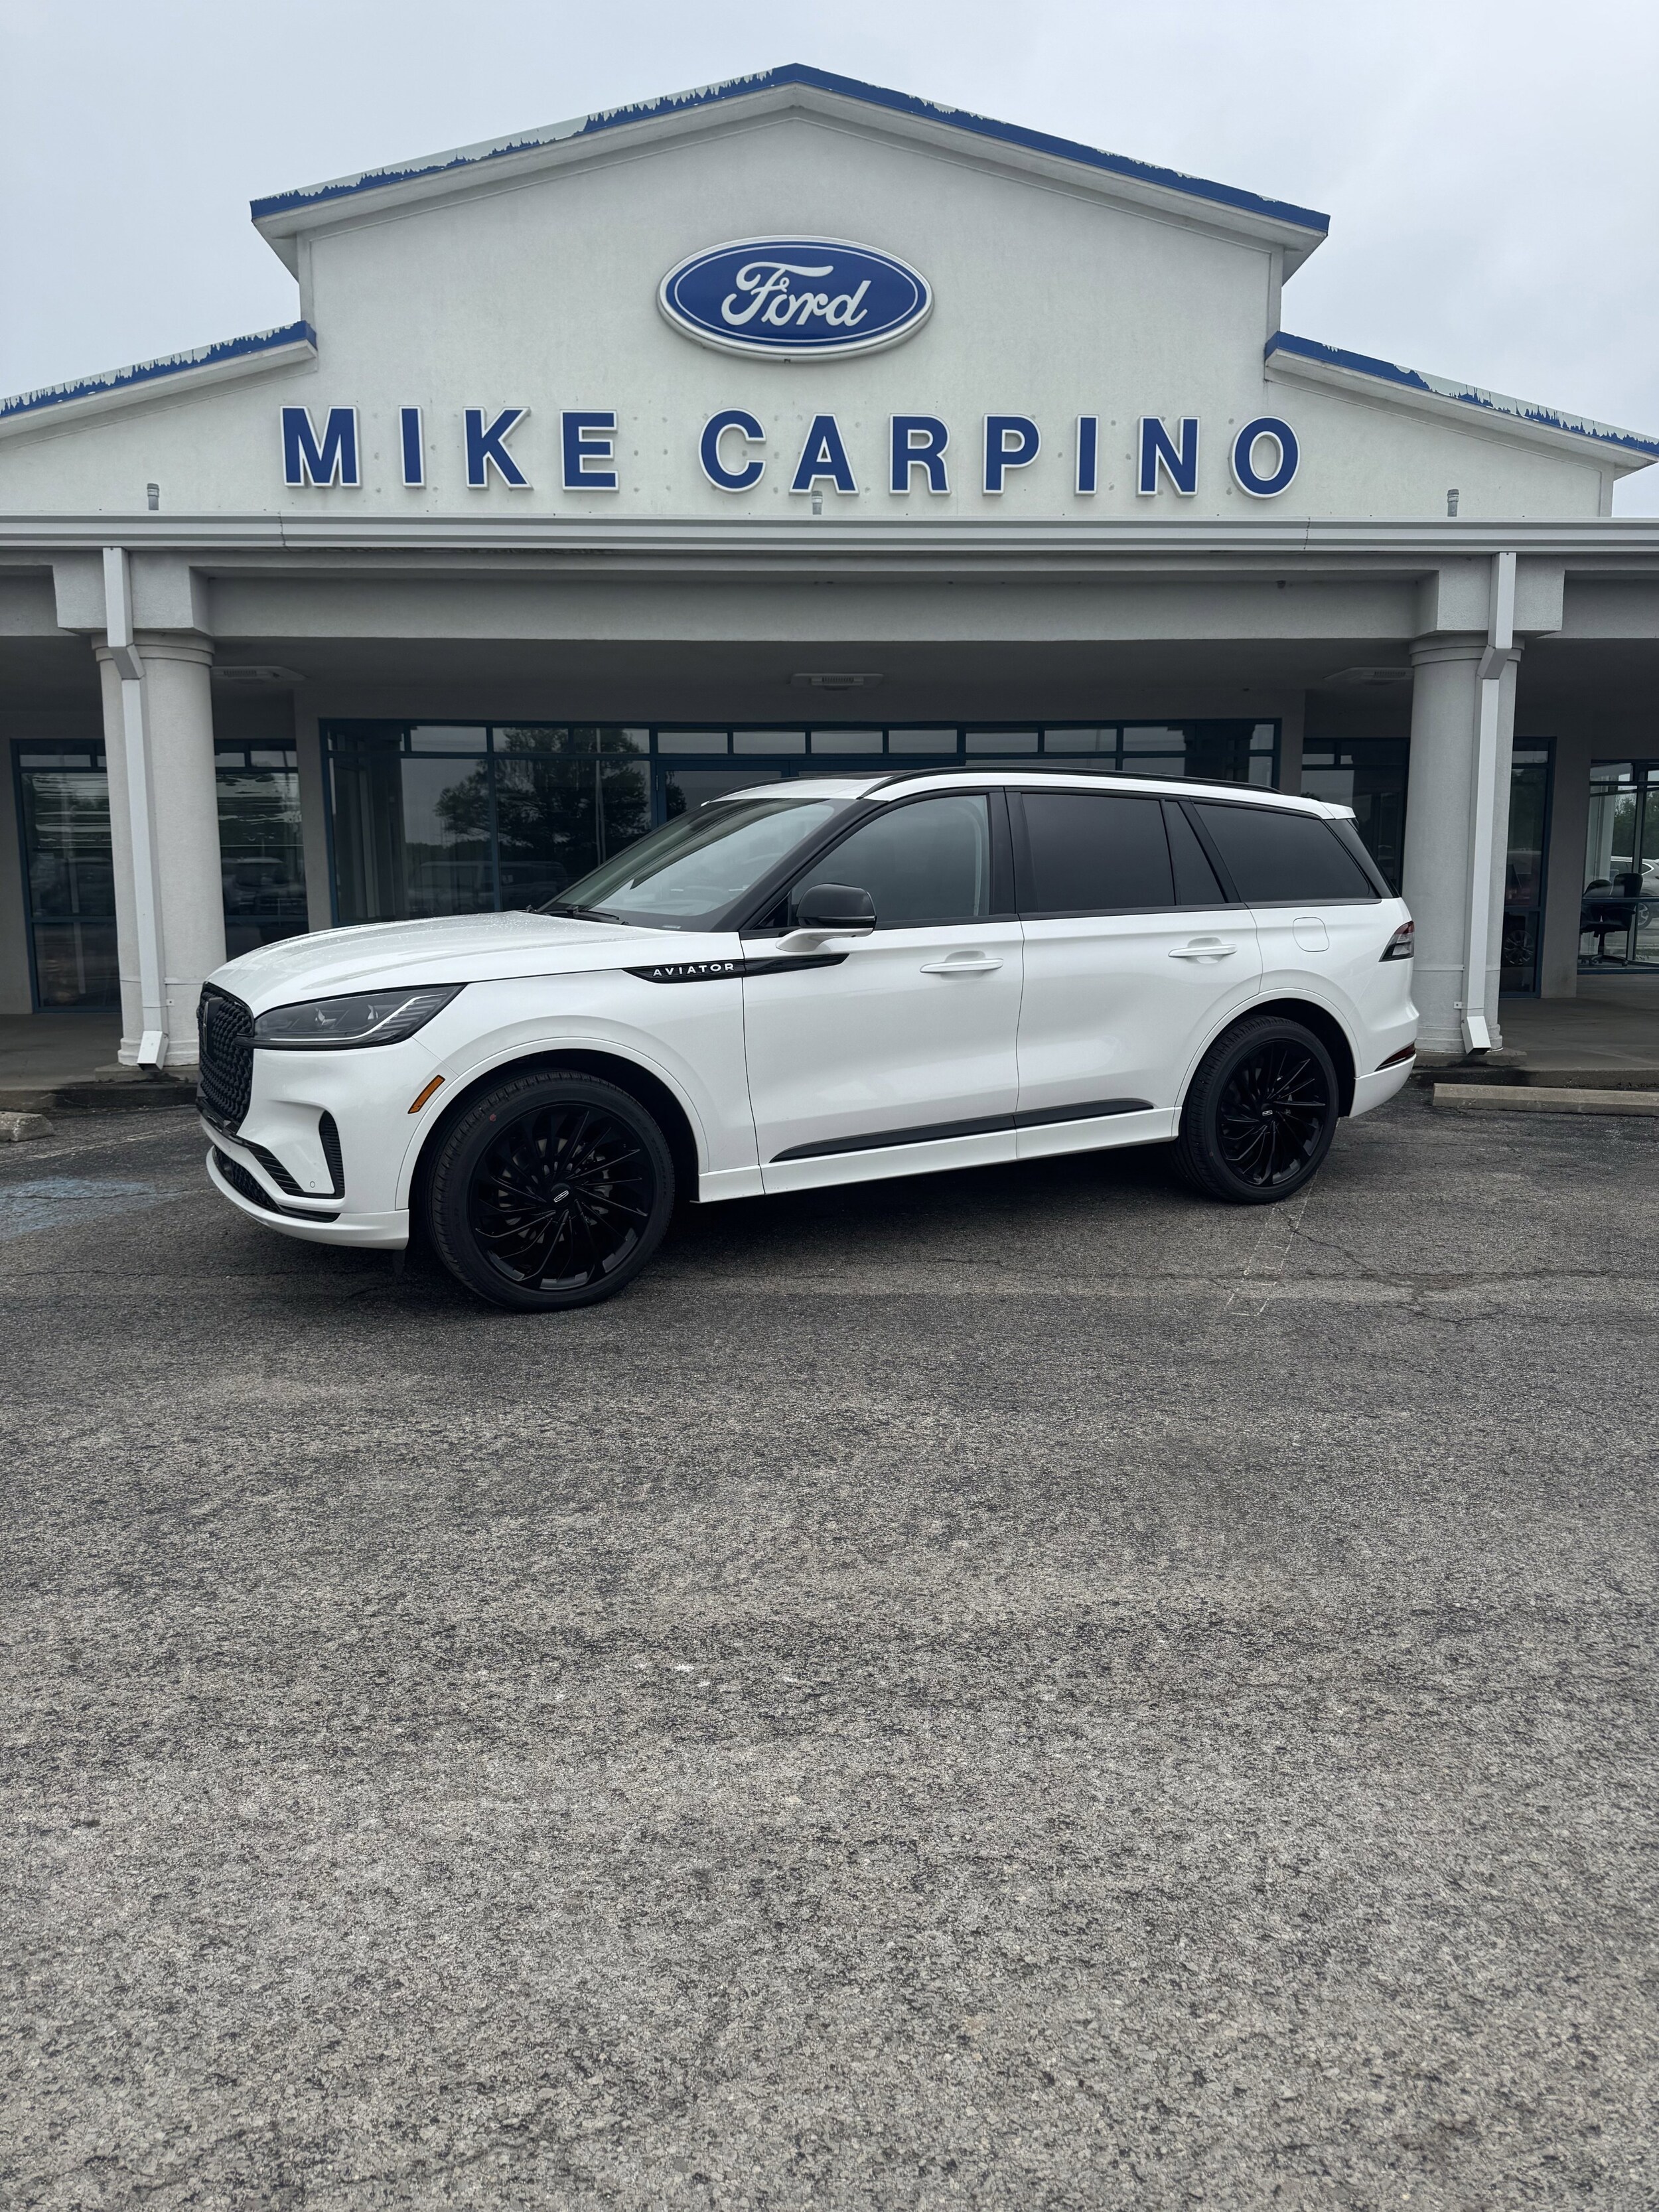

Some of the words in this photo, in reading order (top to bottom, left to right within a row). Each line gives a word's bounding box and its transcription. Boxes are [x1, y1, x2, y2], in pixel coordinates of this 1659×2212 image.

[721, 261, 872, 327] Ford
[281, 407, 618, 489] MIKE
[699, 409, 1300, 496] CARPINO
[652, 963, 734, 977] AVIATOR
